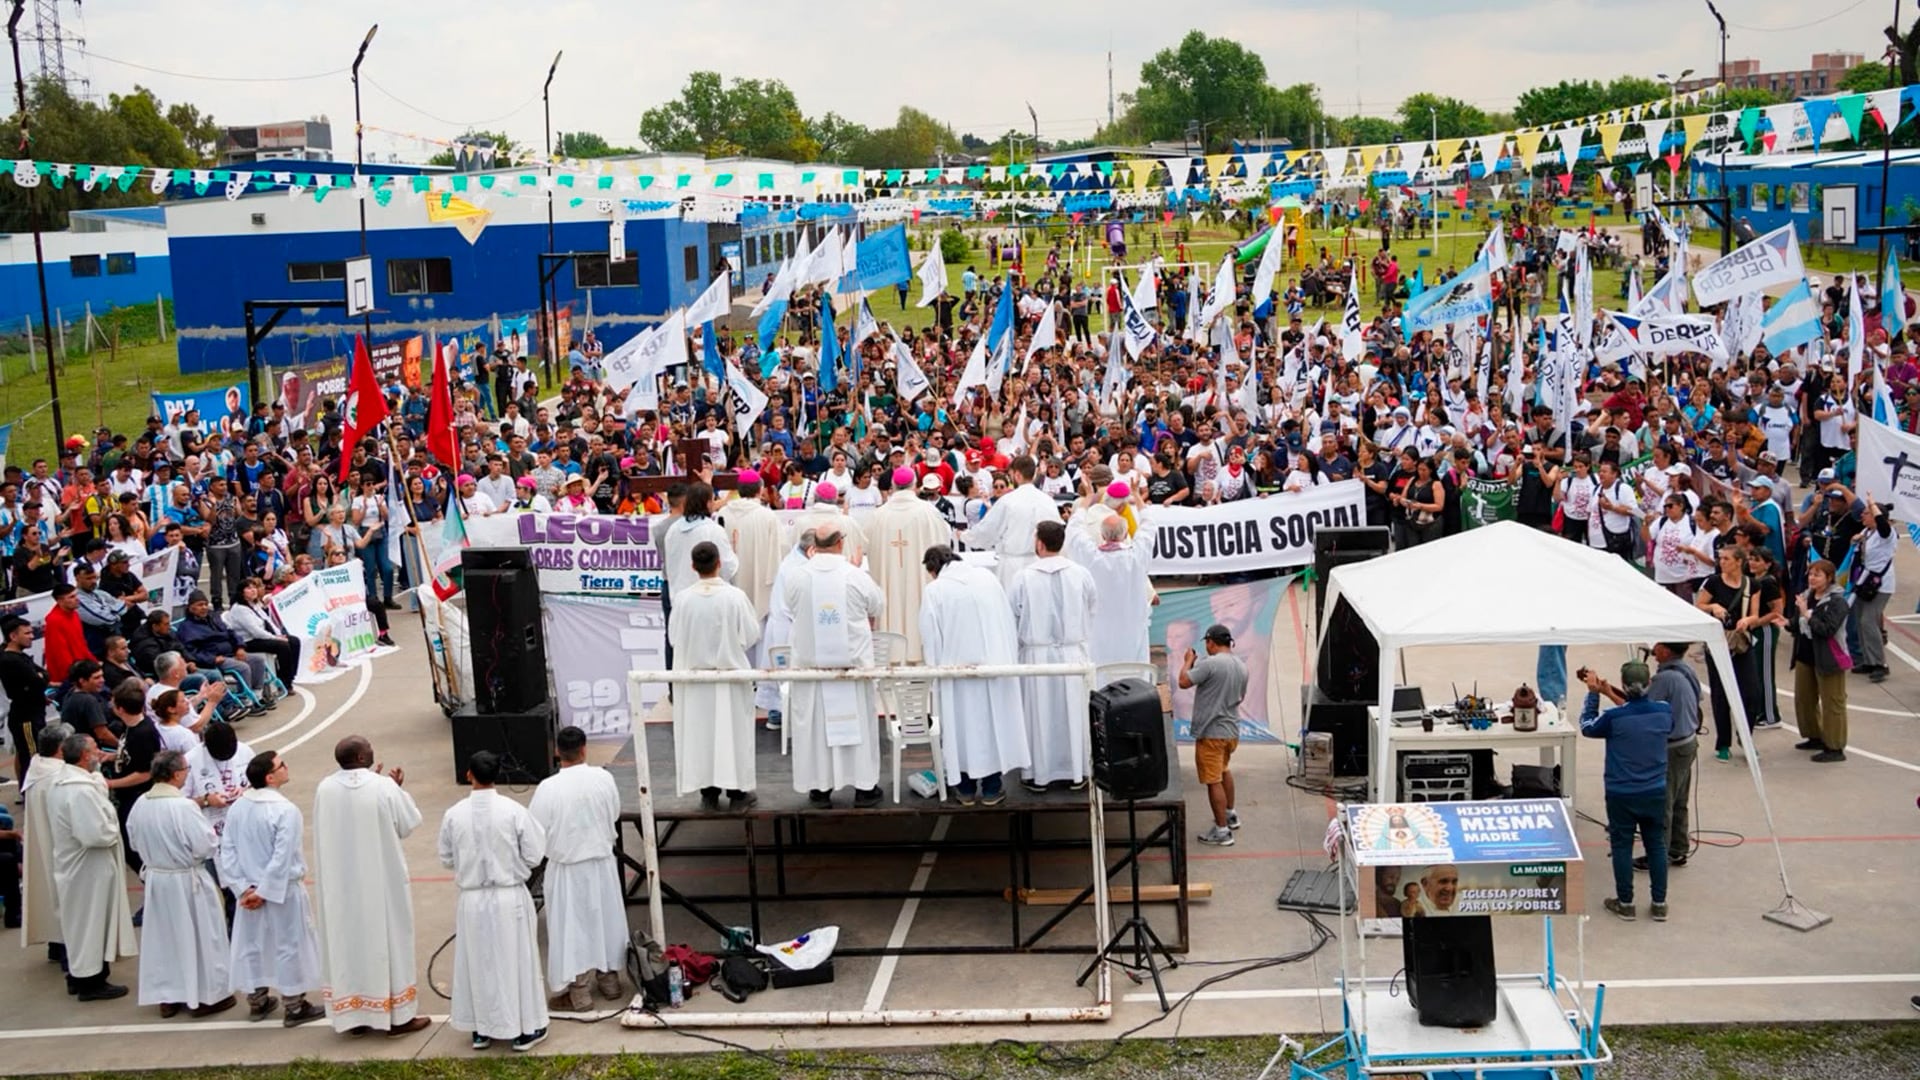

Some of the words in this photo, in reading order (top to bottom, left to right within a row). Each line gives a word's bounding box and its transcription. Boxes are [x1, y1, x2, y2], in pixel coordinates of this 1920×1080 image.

[317, 377, 346, 395] POBRE
[580, 574, 624, 590] Tierra
[1456, 805, 1501, 816] HIJOS
[1503, 804, 1521, 814] DE
[1523, 803, 1555, 814] UNA
[1460, 814, 1554, 831] MISMA
[1463, 831, 1521, 843] MADRE
[1524, 865, 1564, 874] MATANZA
[1462, 889, 1508, 900] IGLESIA
[1510, 888, 1548, 898] POBRE
[1550, 888, 1559, 898] Y
[1459, 901, 1489, 912] PARA
[1491, 901, 1513, 911] LOS
[1515, 900, 1561, 911] POBRES
